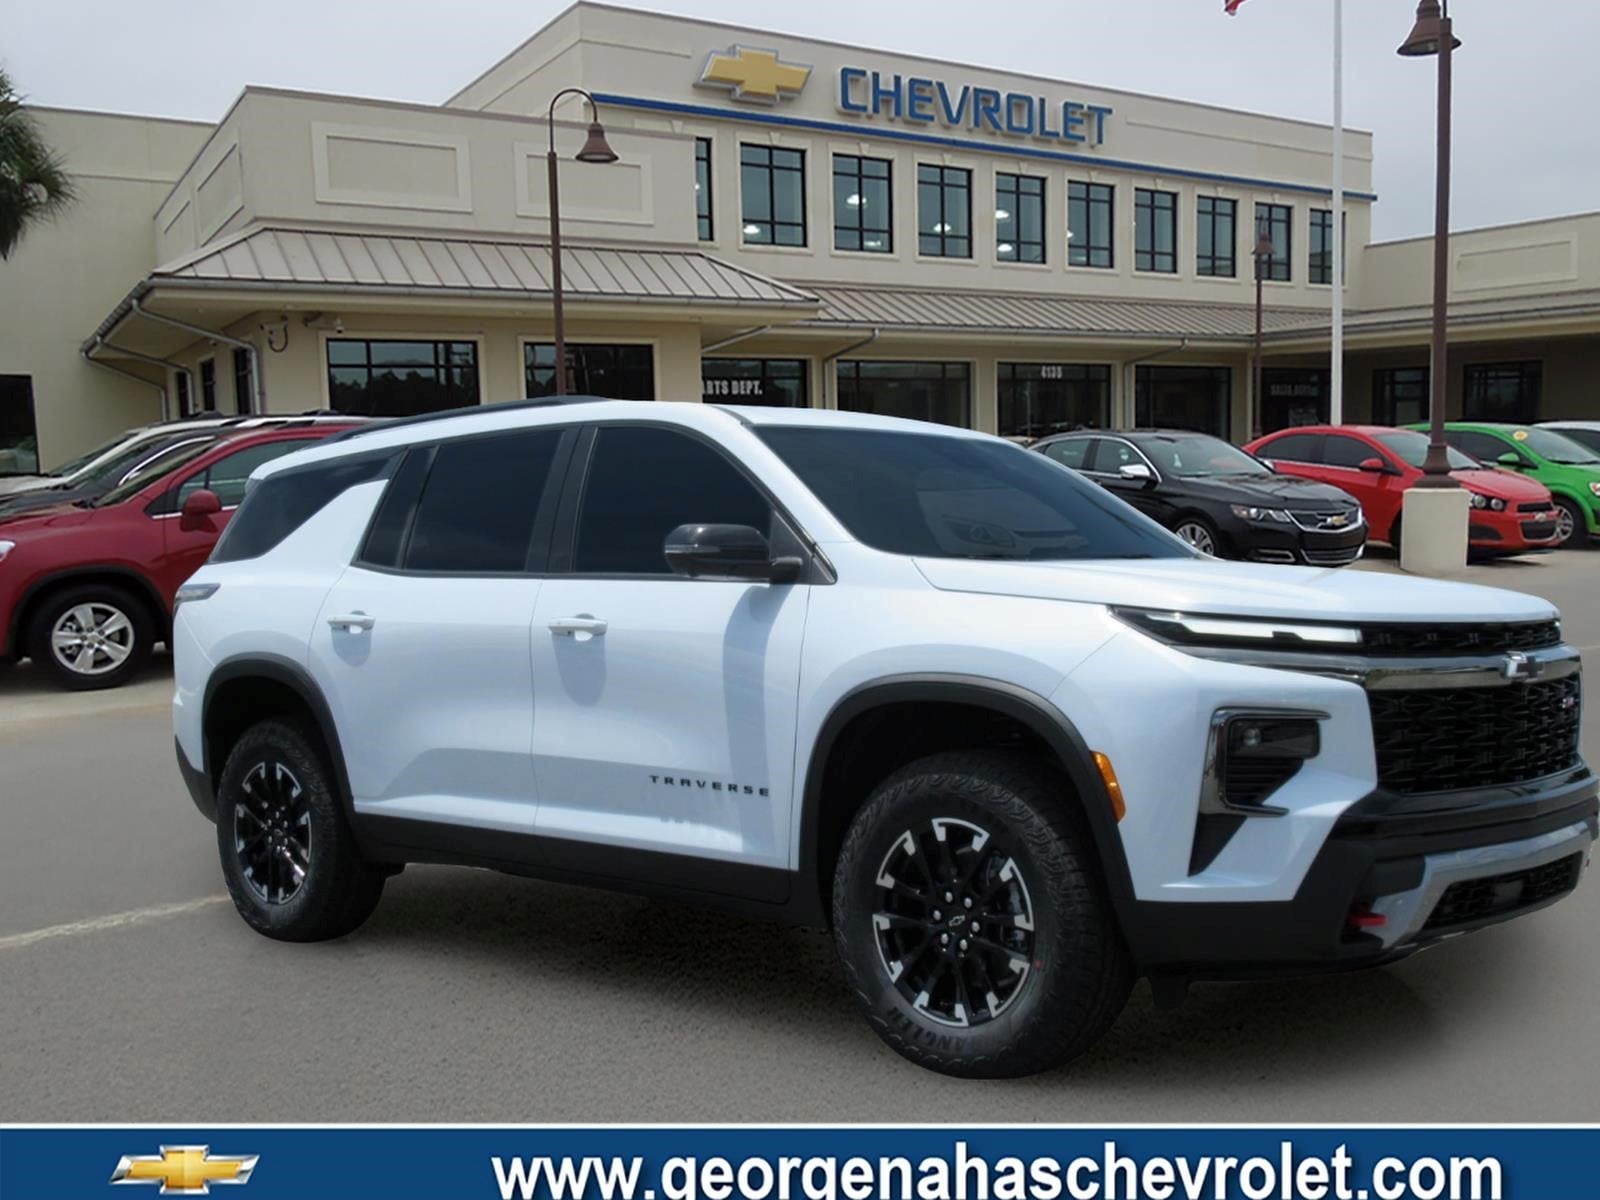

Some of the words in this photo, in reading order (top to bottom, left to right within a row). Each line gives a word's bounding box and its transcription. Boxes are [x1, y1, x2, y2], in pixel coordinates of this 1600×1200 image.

[837, 66, 1113, 146] CHEVROLET
[702, 380, 729, 394] RTS
[732, 380, 763, 394] DEPT.
[648, 774, 769, 797] TRAVERSE
